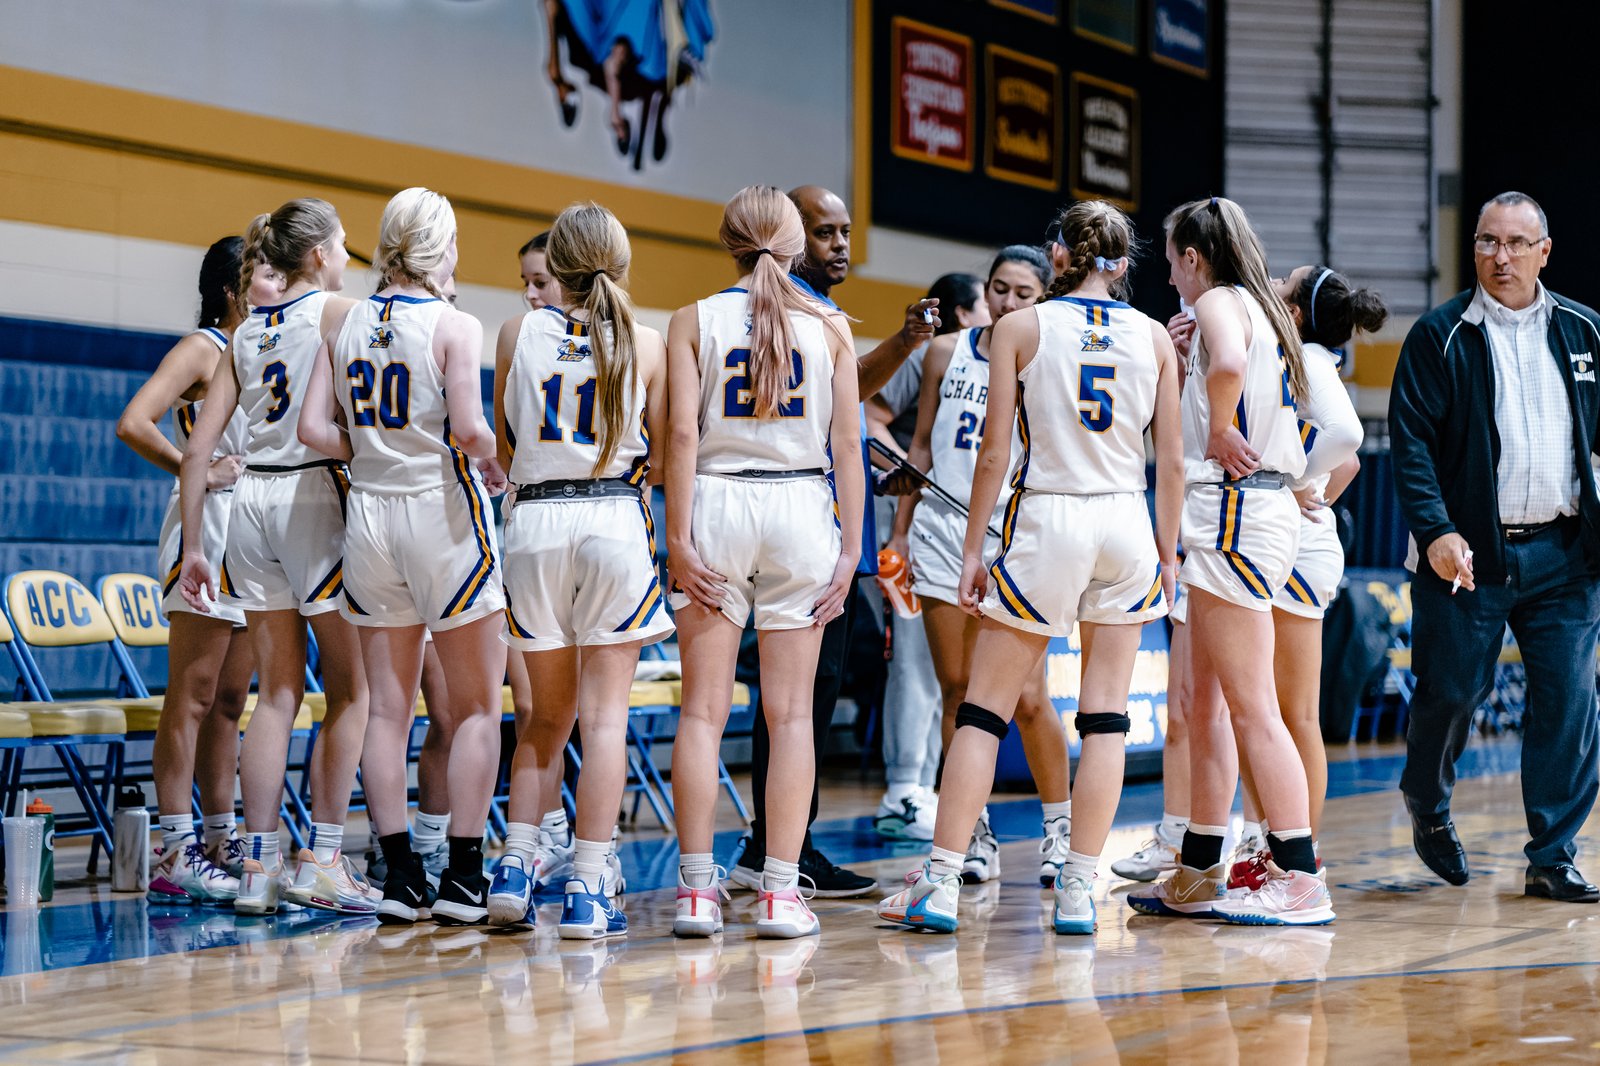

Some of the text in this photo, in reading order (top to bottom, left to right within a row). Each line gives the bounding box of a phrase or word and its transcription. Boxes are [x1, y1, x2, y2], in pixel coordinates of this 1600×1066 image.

[262, 359, 290, 423] 3
[347, 358, 410, 430] 20
[538, 372, 599, 445] 11
[722, 346, 806, 419] 22
[1077, 363, 1116, 434] 5
[23, 580, 92, 628] ACC
